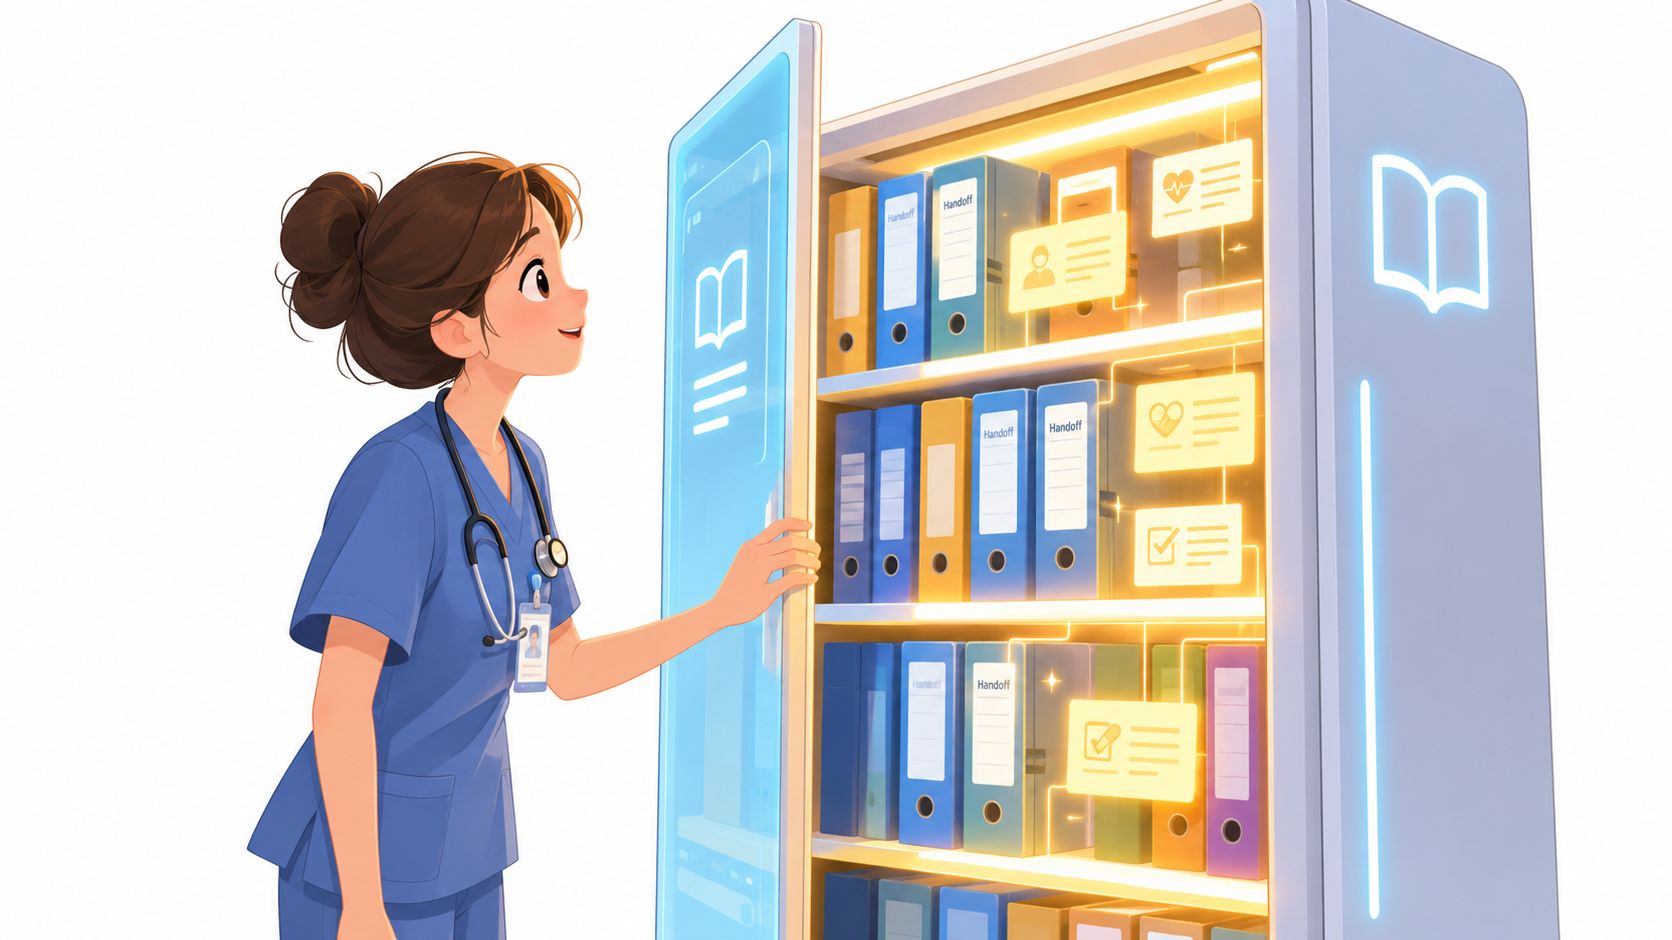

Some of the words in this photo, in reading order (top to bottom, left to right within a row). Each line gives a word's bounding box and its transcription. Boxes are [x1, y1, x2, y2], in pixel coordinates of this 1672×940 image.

[943, 193, 973, 211] Handoff
[983, 425, 1014, 439] Handoff
[1049, 419, 1082, 433] Handoff
[977, 679, 1010, 690] Handoff
